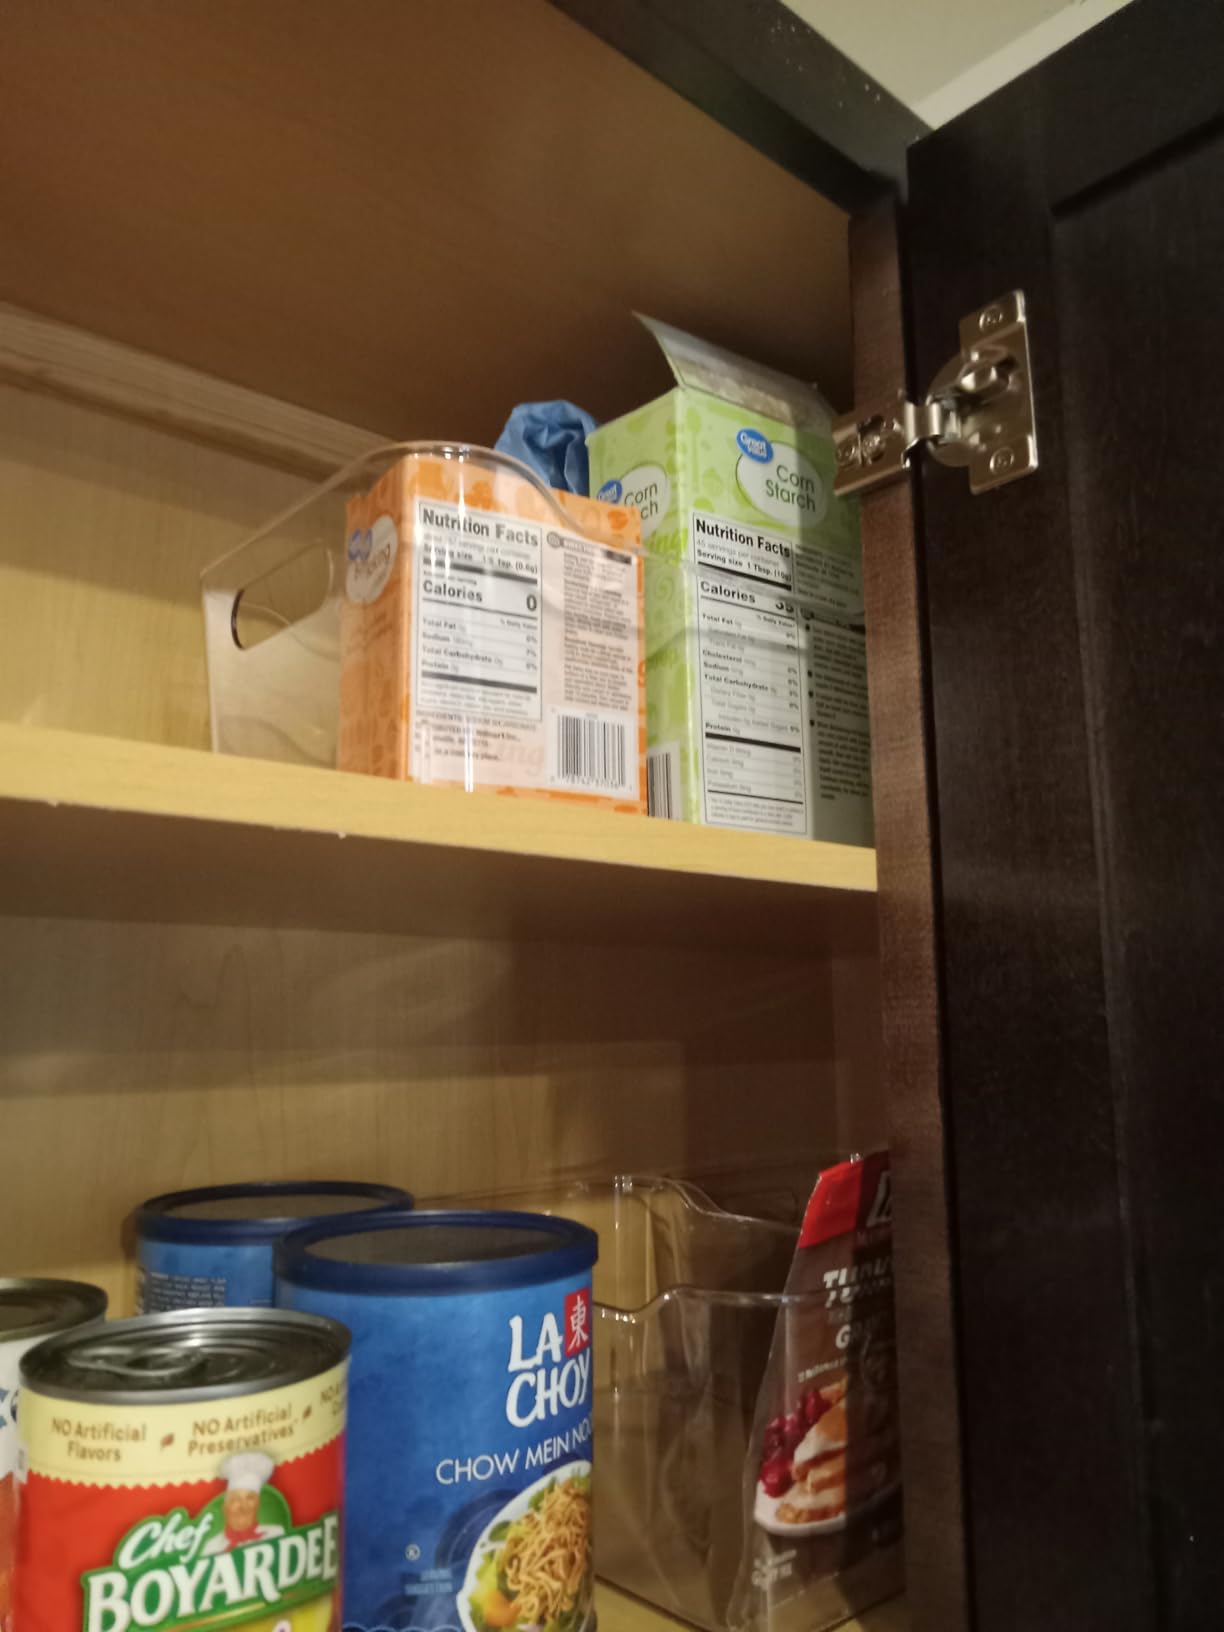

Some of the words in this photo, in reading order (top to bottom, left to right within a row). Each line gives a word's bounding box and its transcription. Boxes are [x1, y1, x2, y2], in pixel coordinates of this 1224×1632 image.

[624, 483, 658, 507] Corn
[766, 479, 816, 512] Starch
[776, 464, 815, 493] Corn
[423, 508, 490, 537] Nutrition
[495, 523, 539, 547] Facts
[696, 519, 754, 548] Nutrition
[757, 536, 791, 558] Facts
[697, 549, 726, 565] Serving
[728, 557, 743, 568] size
[423, 580, 483, 602] Calories
[526, 594, 538, 612] 0
[701, 580, 756, 604] Calories
[568, 1295, 589, 1351] 東
[508, 1312, 564, 1372] LA
[506, 1347, 591, 1428] CHOY
[51, 1416, 72, 1437] NO
[75, 1421, 148, 1443] Artificial
[192, 1417, 221, 1437] NO
[223, 1402, 293, 1433] Artificial
[67, 1439, 122, 1462] Flavors
[436, 1448, 520, 1486] CHOW
[525, 1431, 570, 1471] MEIN
[117, 1512, 214, 1571] Chef
[87, 1513, 339, 1632] BOYARDEE
